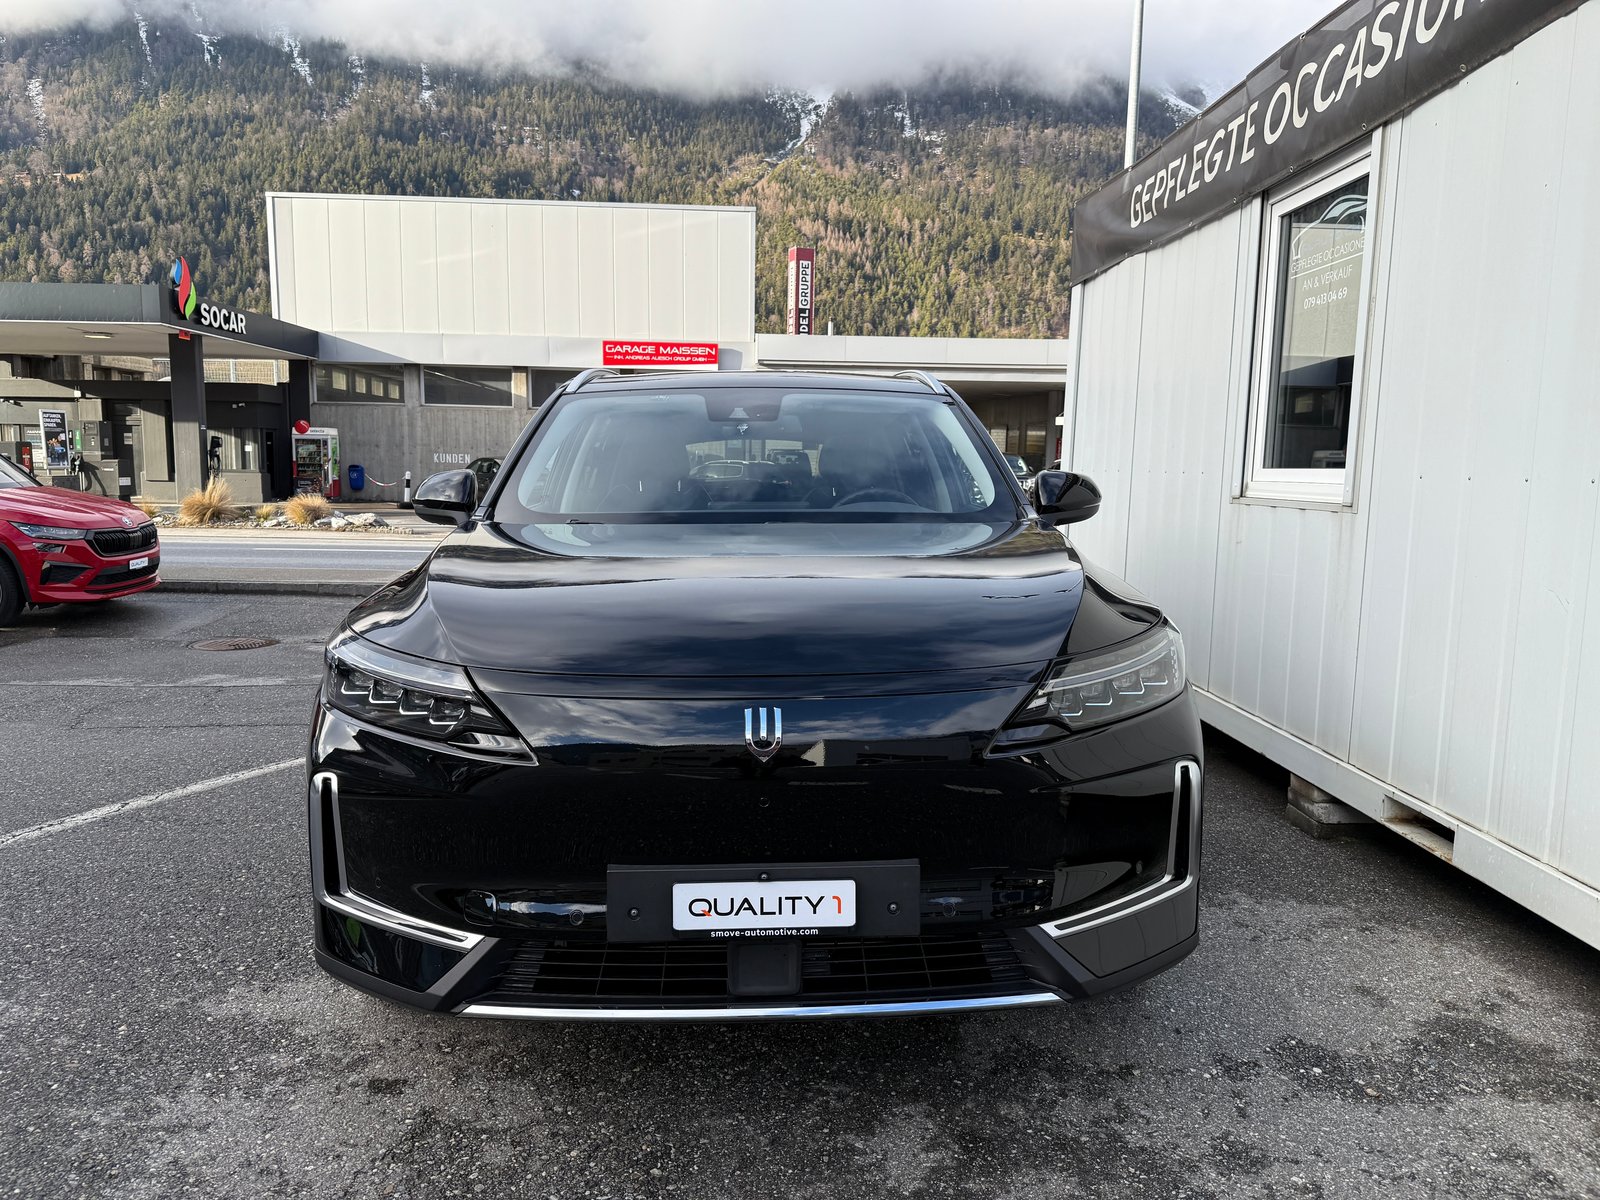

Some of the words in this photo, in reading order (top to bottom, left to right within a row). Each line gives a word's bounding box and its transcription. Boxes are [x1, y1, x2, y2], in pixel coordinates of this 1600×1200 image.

[1130, 101, 1259, 228] GEPFLEGTE
[1263, 0, 1485, 145] OCCASIO
[1291, 252, 1323, 272] GEPFLEGTE
[800, 262, 810, 307] GRUPPE
[1303, 278, 1313, 290] AN
[1313, 276, 1320, 288] &
[1321, 265, 1353, 284] VERKAUF
[1304, 297, 1316, 309] 079
[1316, 293, 1327, 305] 413
[1328, 290, 1337, 302] 04
[1338, 287, 1348, 299] 69
[200, 302, 246, 335] SOCAR
[605, 344, 656, 354] GARAGE
[660, 346, 716, 356] MAISSEN
[433, 453, 471, 464] KUNDEN
[688, 895, 825, 917] QUALITY
[832, 895, 842, 914] 1
[710, 928, 819, 938] smove-automotive.com
